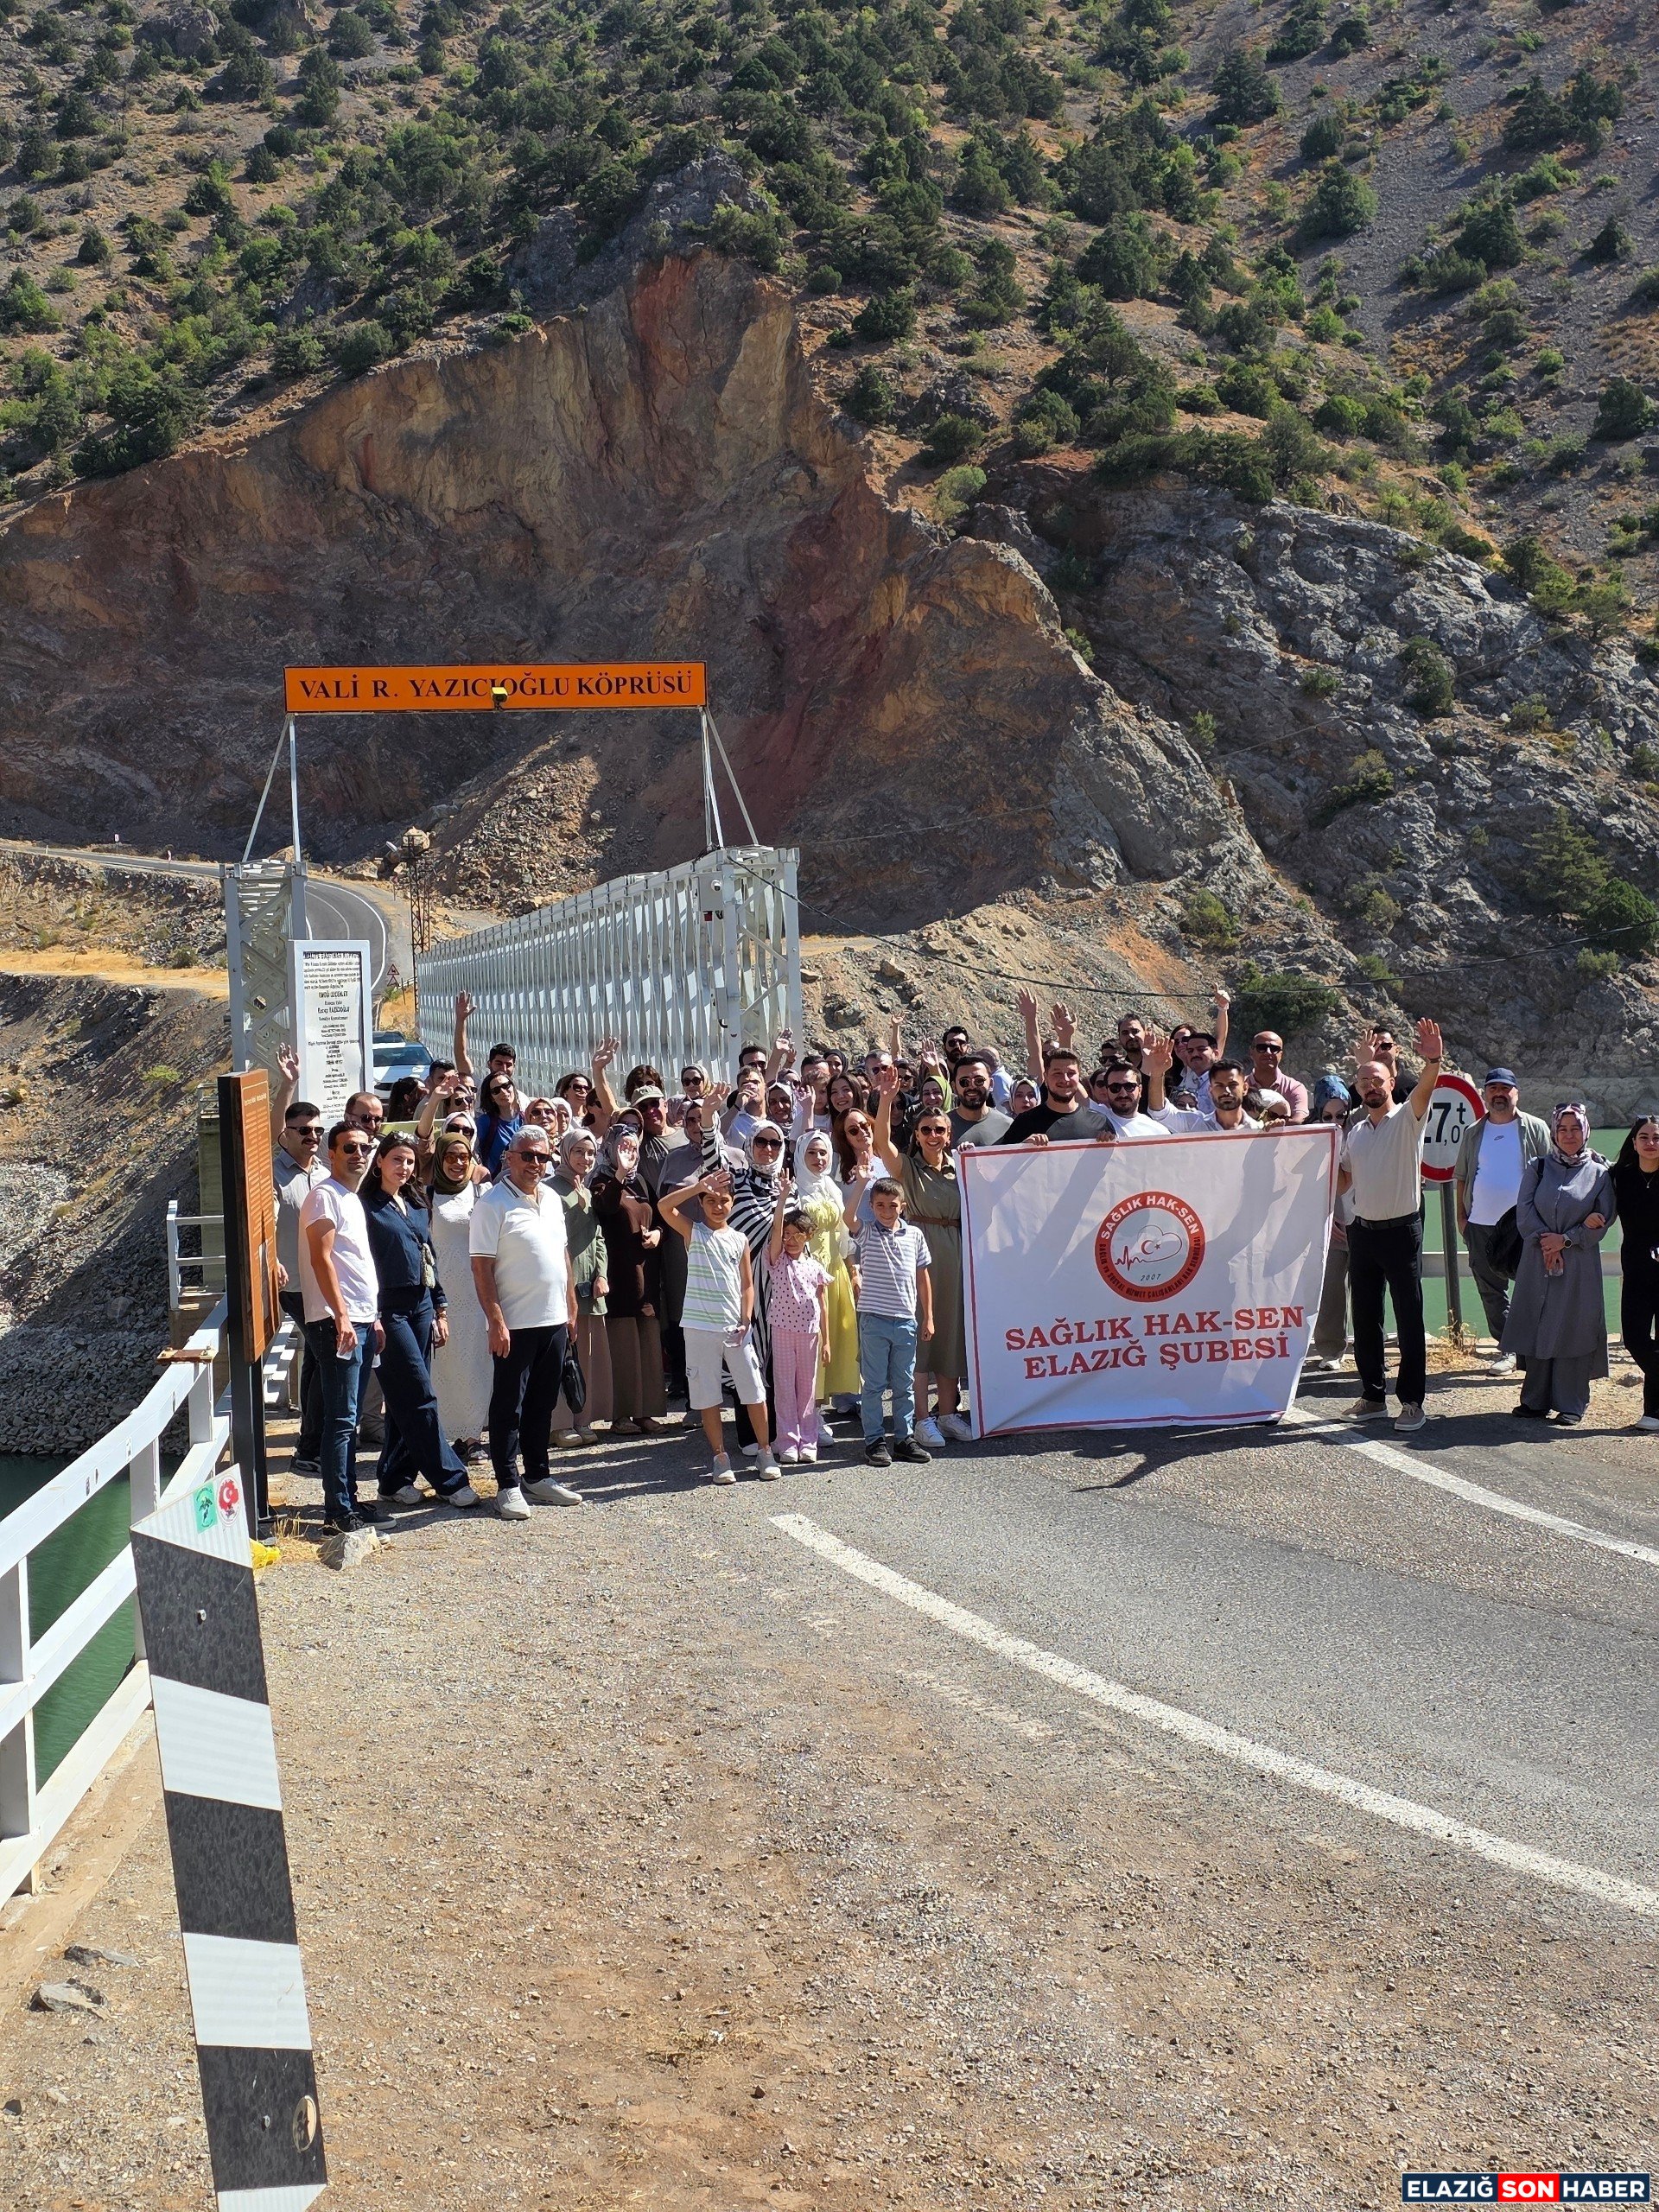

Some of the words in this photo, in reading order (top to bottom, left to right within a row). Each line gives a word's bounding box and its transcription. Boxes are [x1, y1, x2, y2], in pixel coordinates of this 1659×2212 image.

[299, 674, 359, 699] VALİ
[372, 679, 398, 698] R.
[577, 671, 693, 695] KÖPRÜSÜ
[1101, 1197, 1142, 1240] SAĞLIK
[1147, 1195, 1199, 1235] HAK-SEN
[1005, 1316, 1134, 1351] SAĞLIK
[1143, 1306, 1305, 1338] HAK-SEN
[1024, 1339, 1147, 1380] ELAZIĞ
[1160, 1332, 1291, 1371] ŞUBESİ
